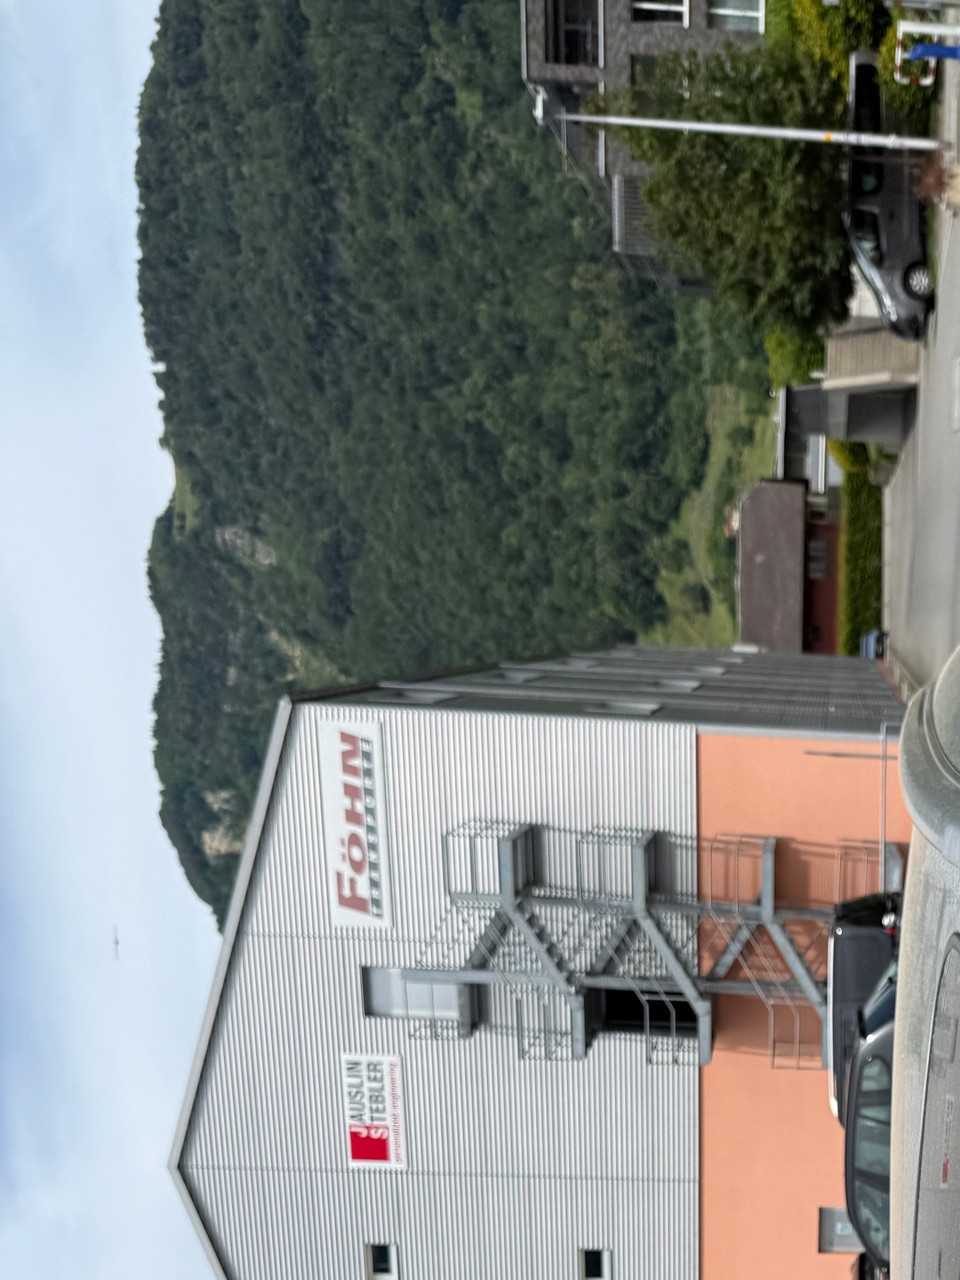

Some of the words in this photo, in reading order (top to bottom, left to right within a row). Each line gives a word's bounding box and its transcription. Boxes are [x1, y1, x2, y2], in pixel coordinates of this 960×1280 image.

[335, 731, 371, 914] FÖHN
[361, 739, 383, 916] TRANSPORTE
[346, 1061, 368, 1139] JAUSLIN
[367, 1061, 389, 1139] STEBLER
